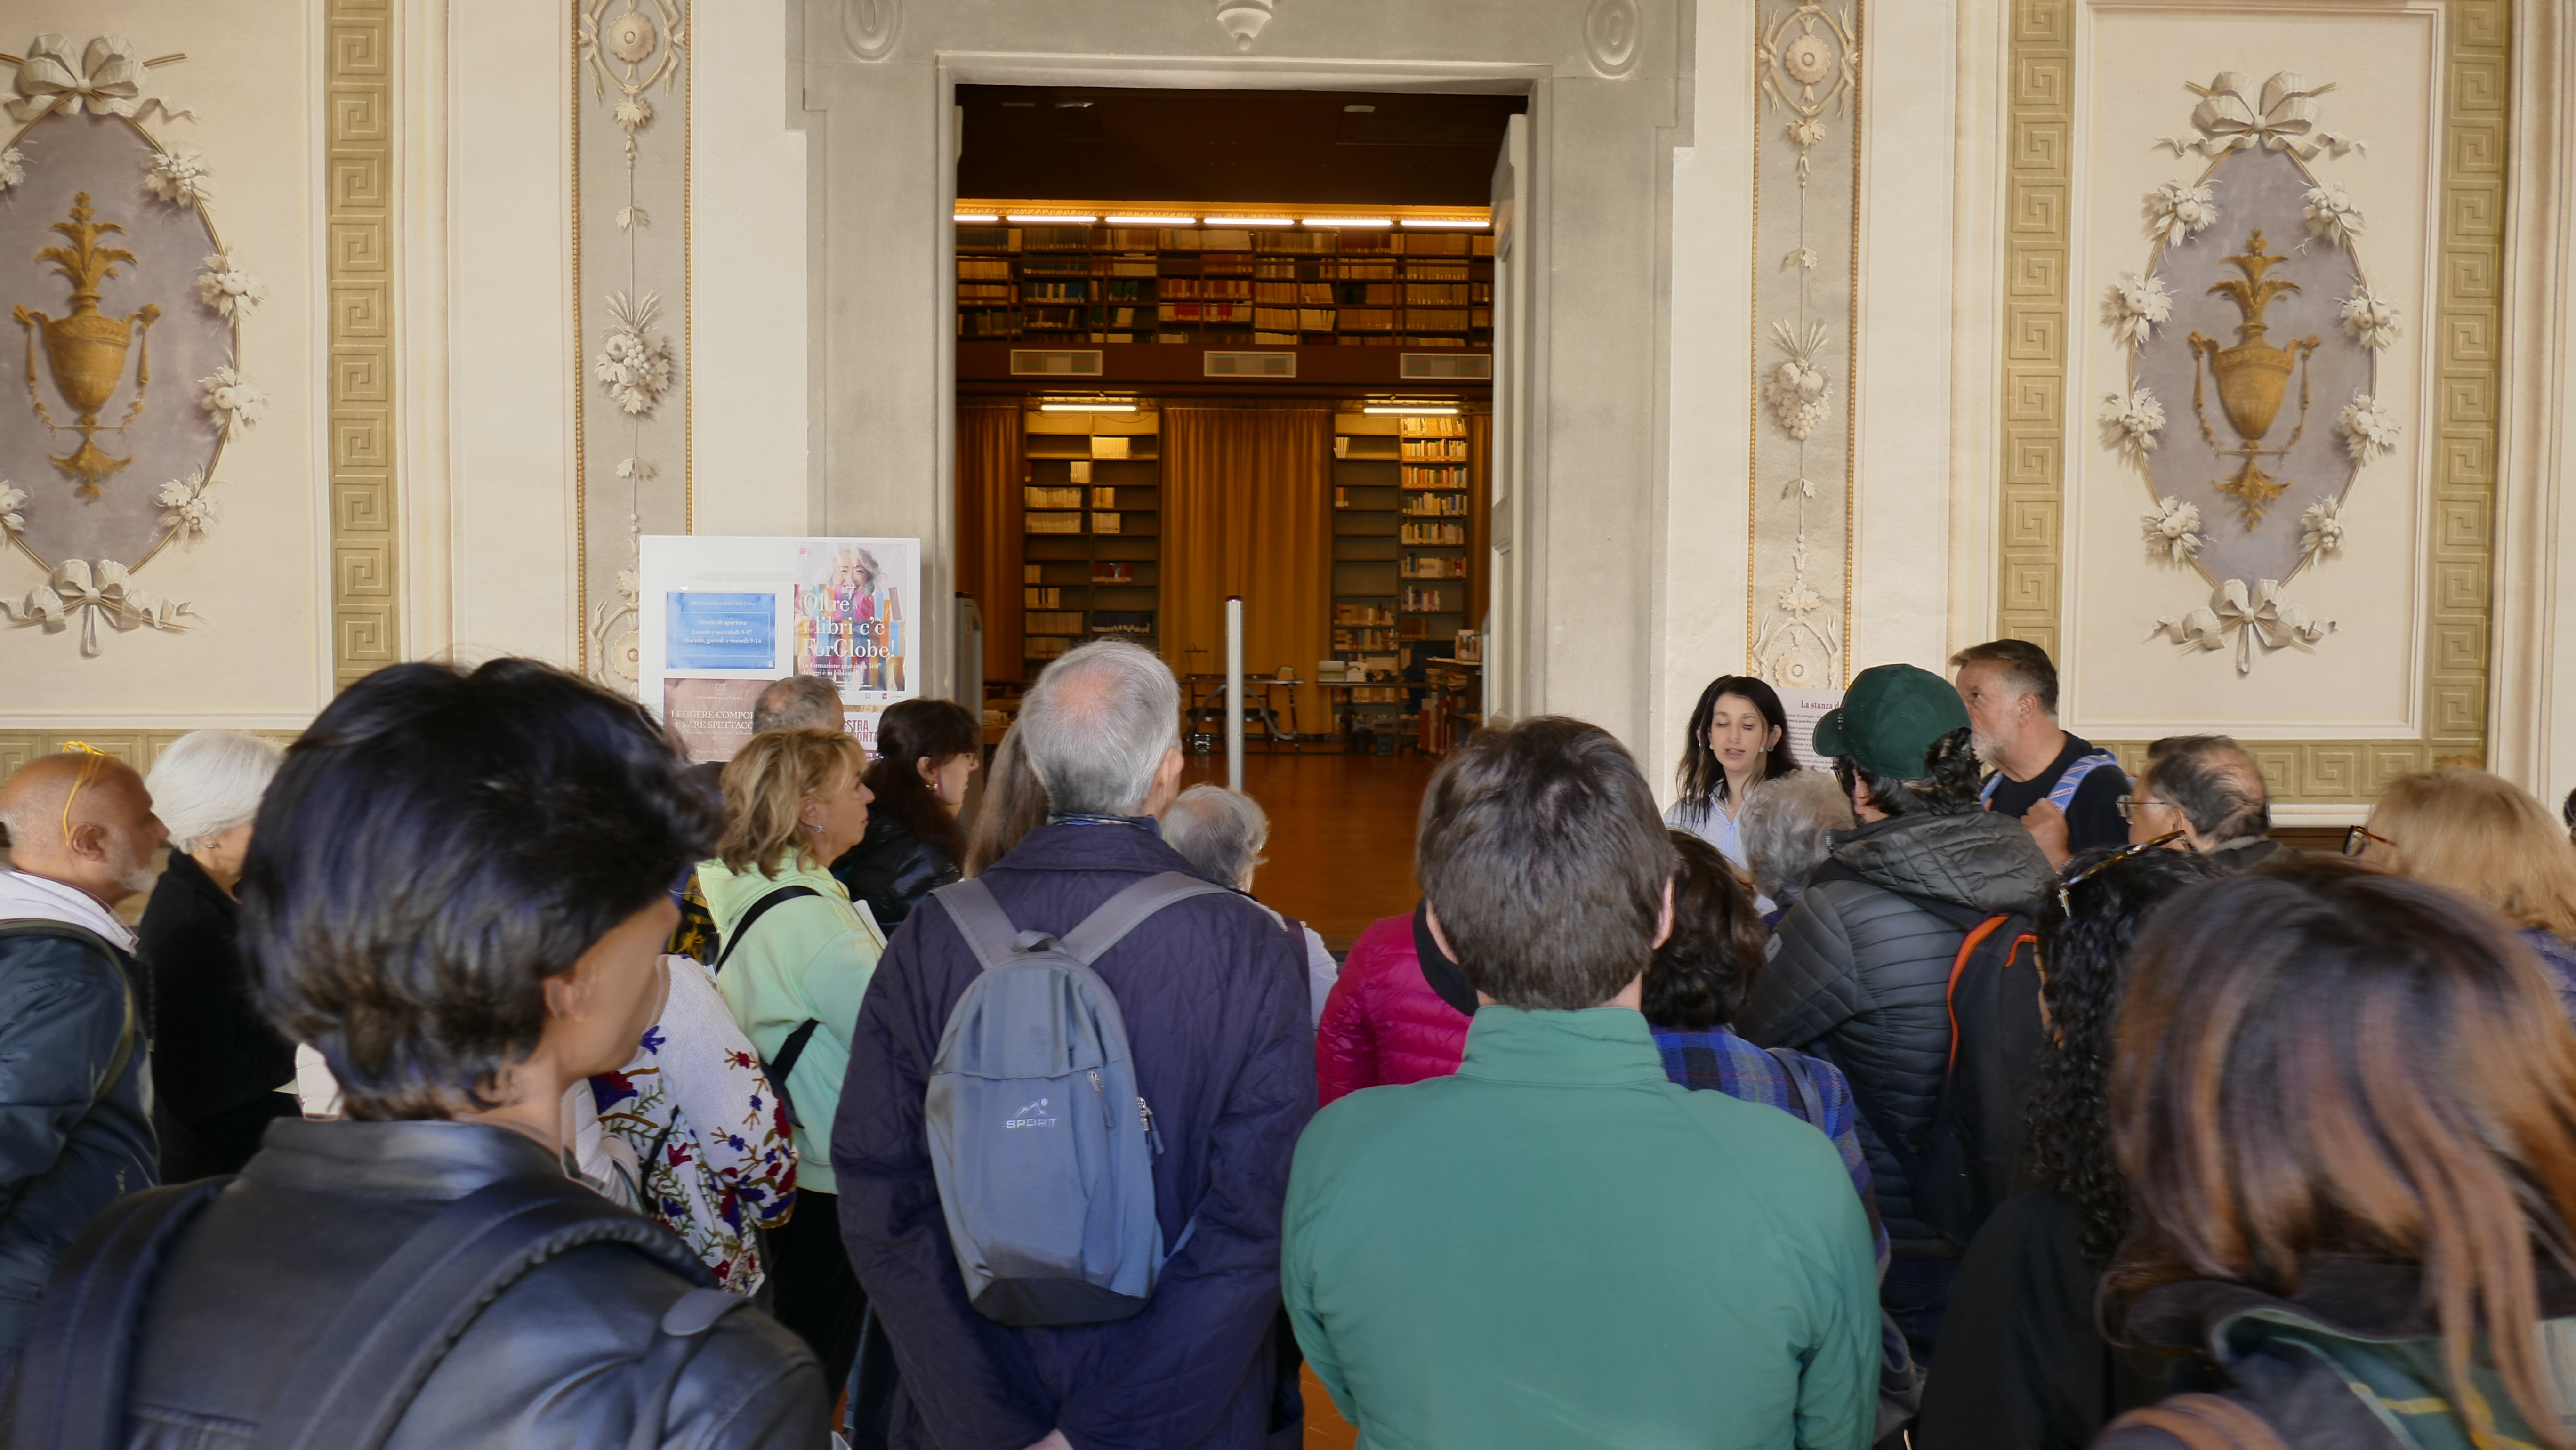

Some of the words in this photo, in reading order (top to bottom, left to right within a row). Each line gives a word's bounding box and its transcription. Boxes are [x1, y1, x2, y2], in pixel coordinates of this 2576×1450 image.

[804, 593, 850, 612] Olre
[814, 615, 853, 635] libri
[805, 638, 894, 658] ForGlobe!
[1801, 700, 1809, 709] La
[671, 710, 714, 719] LEGGERE
[1005, 1118, 1057, 1128] SPORT
